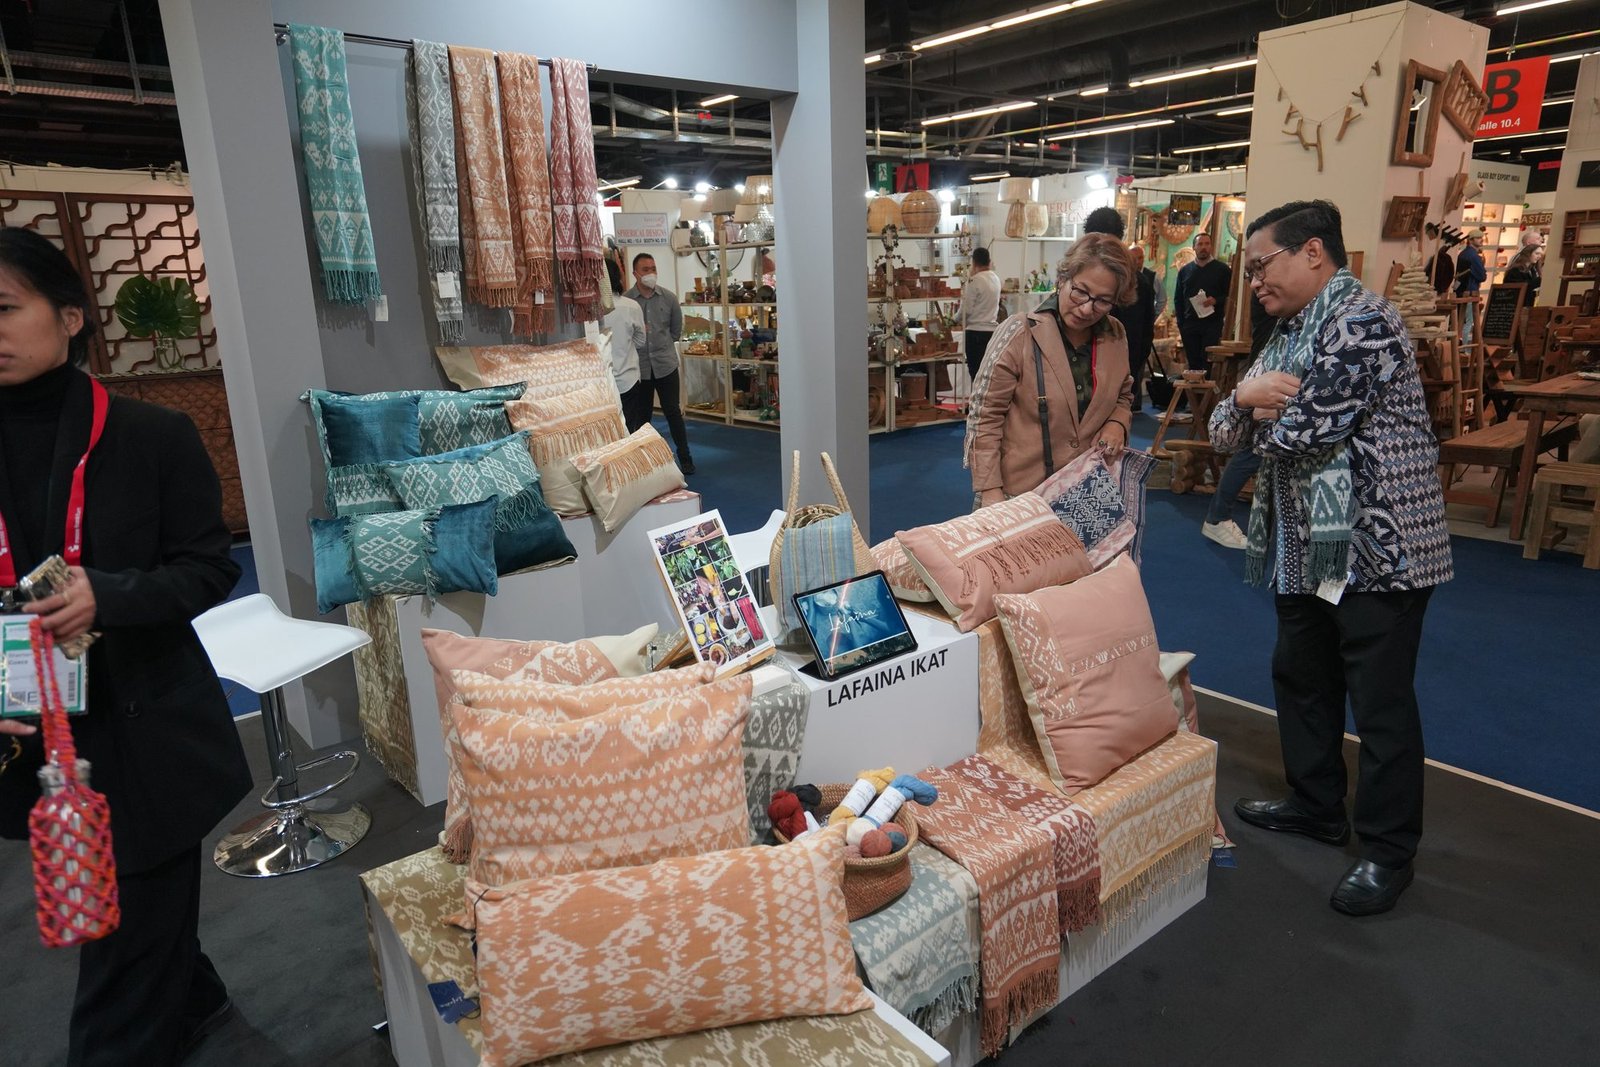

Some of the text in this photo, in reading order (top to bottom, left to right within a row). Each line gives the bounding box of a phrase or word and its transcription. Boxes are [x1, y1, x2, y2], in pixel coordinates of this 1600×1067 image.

[1484, 68, 1522, 116] B
[1477, 117, 1521, 131] alle 10.4
[903, 169, 919, 191] A
[828, 609, 878, 633] Lafaina
[827, 648, 949, 708] LAFAINA IKAT
